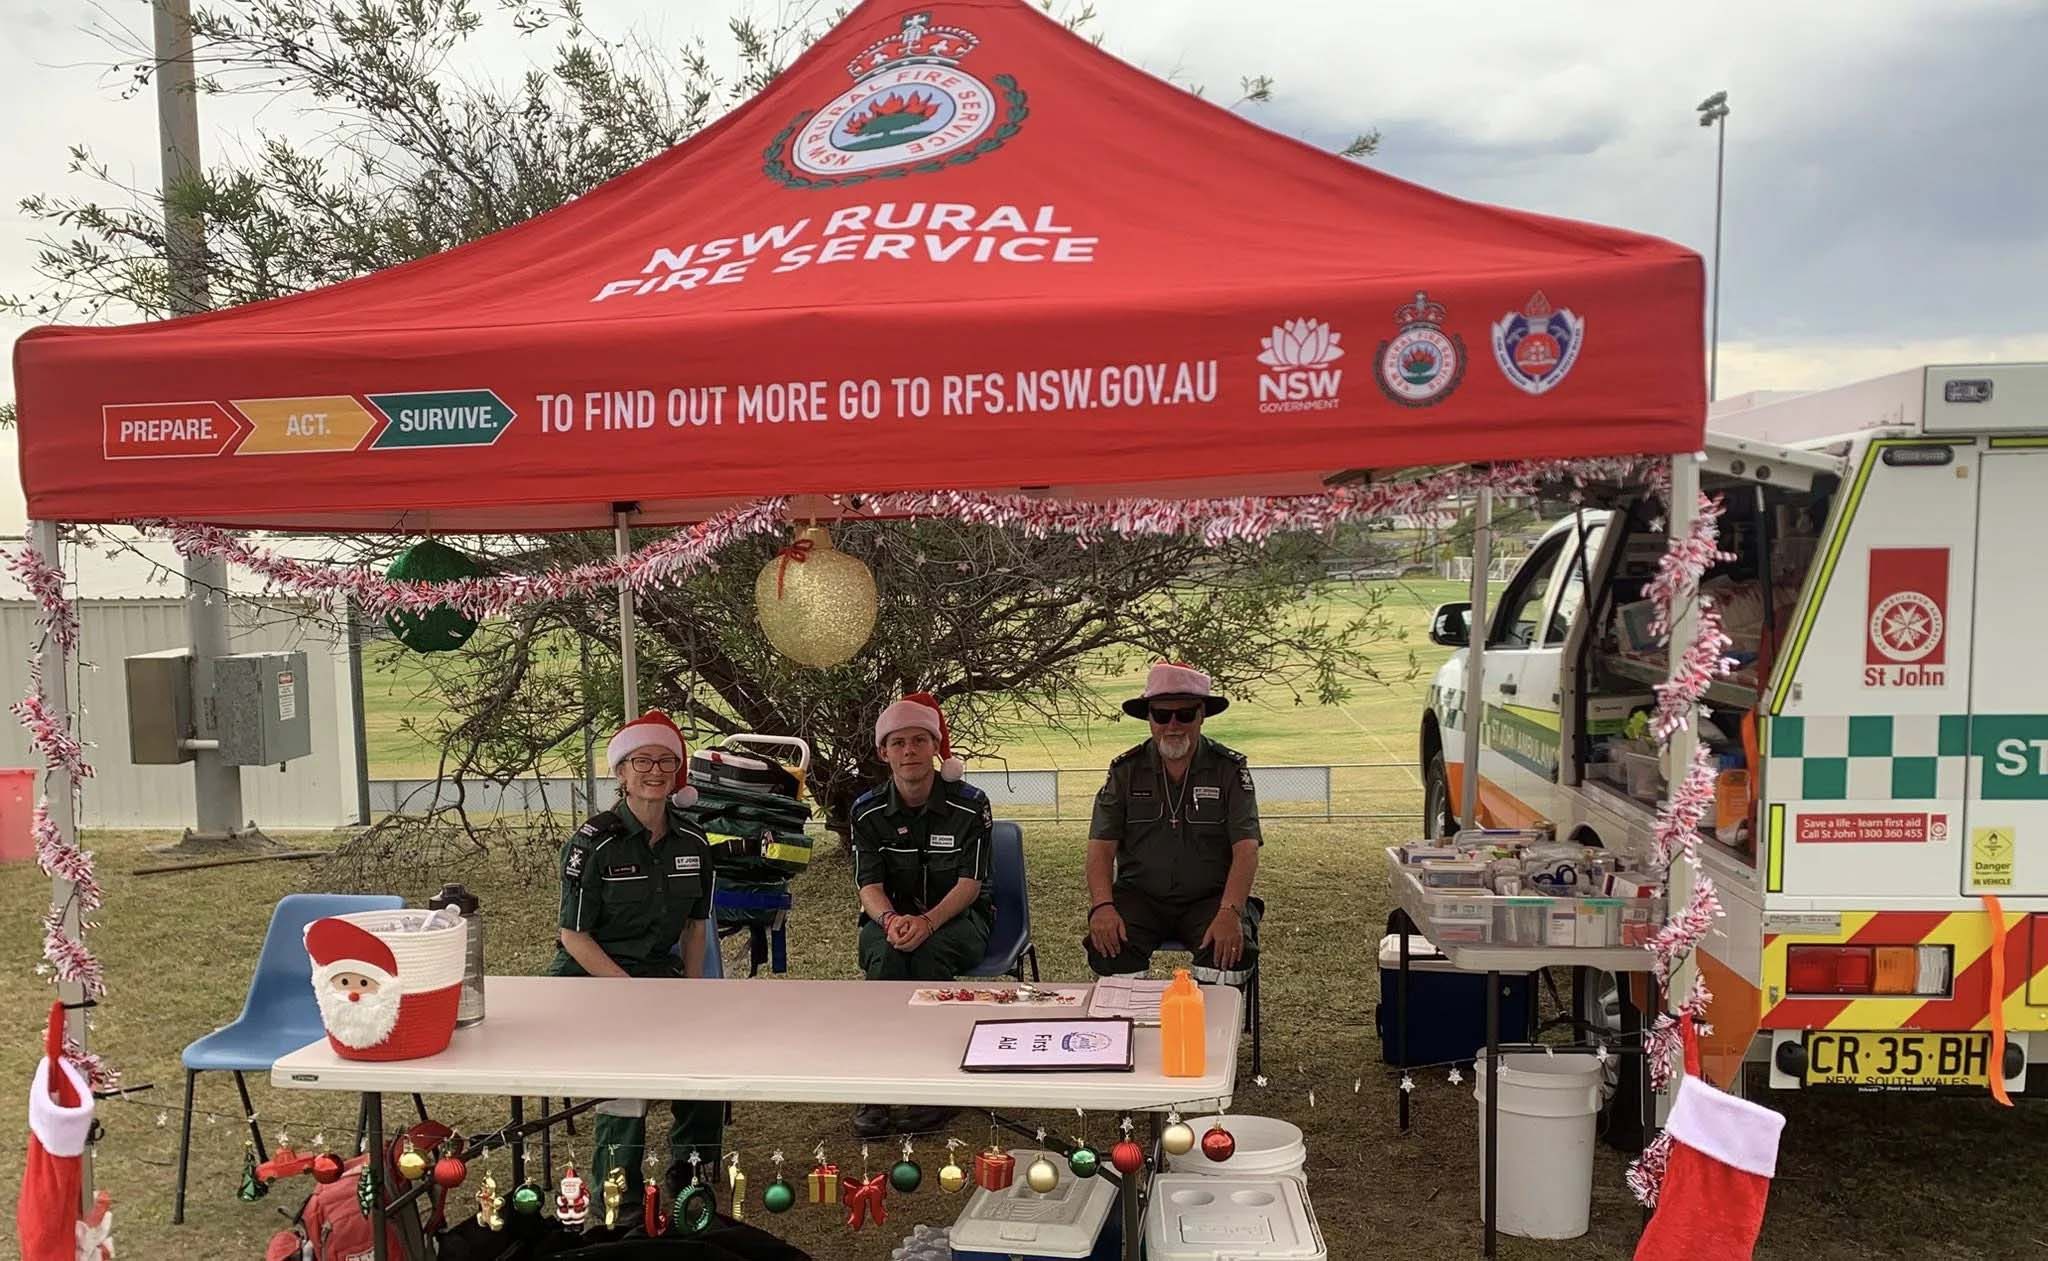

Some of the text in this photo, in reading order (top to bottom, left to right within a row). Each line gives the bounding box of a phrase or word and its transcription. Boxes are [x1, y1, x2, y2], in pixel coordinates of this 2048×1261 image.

[807, 69, 983, 168] NSW RURAL FIRE SERVICE
[639, 202, 1074, 274] NSW RURAL
[588, 232, 1100, 303] FIRE SERVICE
[536, 359, 1218, 433] TO FIND OUT MORE GO TO RFS.NSW.GOV.AU
[1259, 370, 1342, 402] NSW
[399, 405, 499, 432] SURVIVE.
[1258, 399, 1340, 414] GOVERNMENT
[120, 418, 219, 443] PREPARE.
[285, 413, 331, 437] ACT.
[1864, 664, 1945, 687] St John
[1995, 738, 2048, 776] ST
[1801, 829, 1923, 839] Call St John 1300 360 455
[1803, 818, 1826, 828] Save
[1827, 820, 1834, 828] a
[1836, 818, 1850, 828] life
[1858, 818, 1882, 828] learn
[1884, 818, 1904, 828] first
[1905, 818, 1921, 828] aid
[1975, 862, 2011, 872] Danger
[998, 1035, 1018, 1051] Aid
[1031, 1033, 1053, 1053] First
[1825, 1075, 1970, 1085] NEW SOUTH WALES
